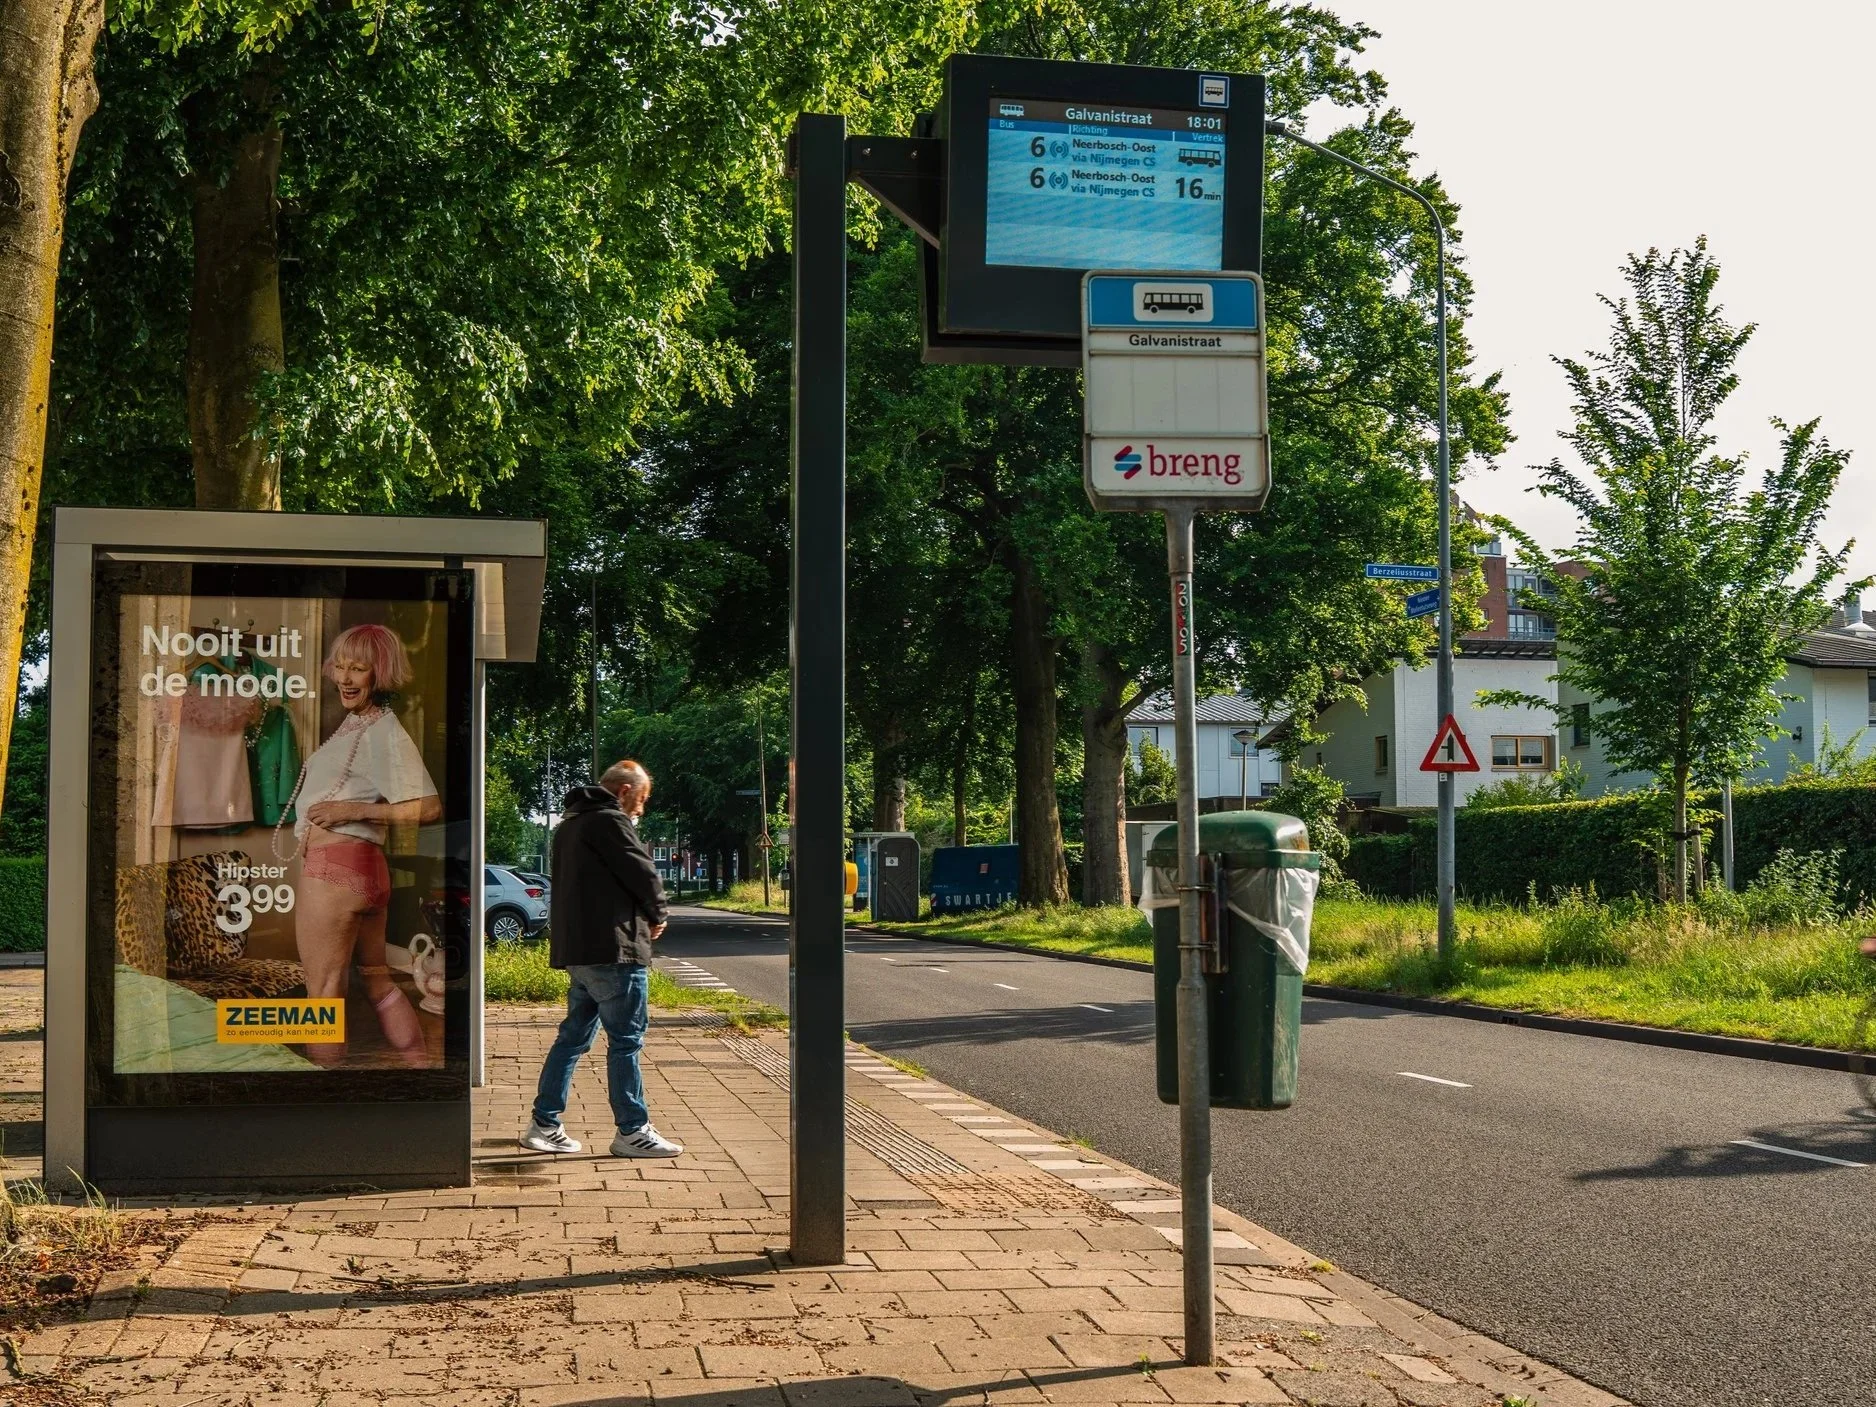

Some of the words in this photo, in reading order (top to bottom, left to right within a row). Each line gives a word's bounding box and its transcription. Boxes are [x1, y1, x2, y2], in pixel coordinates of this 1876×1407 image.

[1065, 107, 1153, 125] Galvanistraat
[1187, 116, 1222, 130] 18:01
[999, 119, 1015, 129] Bus
[1072, 125, 1108, 136] Richting
[1192, 132, 1224, 143] Vertrek
[1031, 136, 1046, 158] 6
[1072, 138, 1156, 153] Neerbosch-Oost
[1072, 154, 1087, 162] via
[1090, 154, 1140, 167] Nijmegen
[1143, 157, 1156, 167] CS
[1030, 167, 1045, 189] 6
[1071, 169, 1156, 184] Neerbosch-Oost
[1071, 184, 1086, 194] via
[1089, 184, 1139, 198] Nijmegen
[1142, 187, 1155, 198] CS
[1176, 177, 1204, 200] 16
[1204, 191, 1222, 201] min
[1128, 334, 1222, 348] Galvanistraat
[1146, 444, 1242, 486] breng
[1373, 567, 1432, 577] Berzeliusstraat
[142, 625, 243, 657] Nooit
[256, 627, 302, 658] uit
[140, 666, 188, 697] de
[200, 668, 316, 699] mode.
[218, 862, 288, 882] Hipster
[226, 1006, 336, 1026] ZEEMAN
[240, 1029, 284, 1037] eenvoudig
[305, 1028, 319, 1036] het
[321, 1027, 336, 1037] zijn
